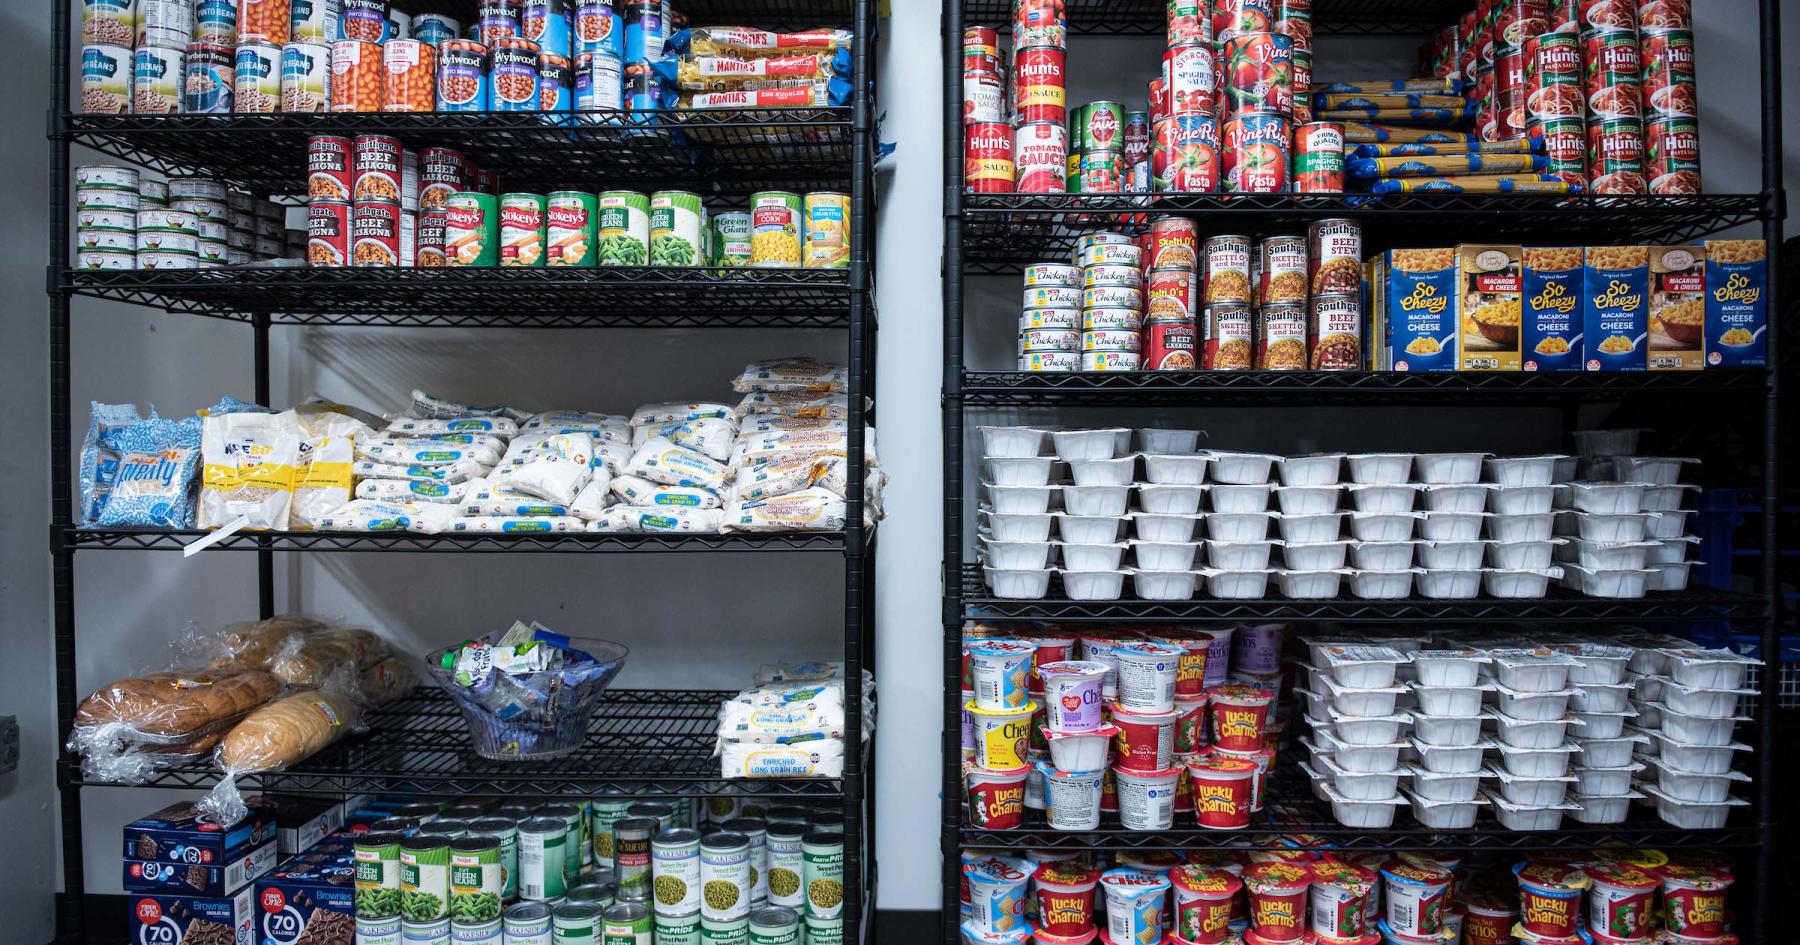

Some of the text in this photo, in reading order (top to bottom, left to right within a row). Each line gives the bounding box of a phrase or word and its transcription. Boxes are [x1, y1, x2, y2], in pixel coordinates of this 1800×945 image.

[210, 53, 230, 62] Beans
[496, 50, 537, 66] Wylwood
[1255, 43, 1289, 64] Vine
[440, 54, 480, 67] Wylwood
[1176, 52, 1195, 69] STAR
[90, 61, 115, 72] BEANS
[1547, 75, 1578, 83] Traditional
[709, 92, 747, 105] MANTIA'S
[1033, 89, 1061, 98] SAUCE
[1087, 120, 1120, 133] SAUCE
[1164, 128, 1200, 148] Vine
[1230, 128, 1264, 150] Vine
[1023, 145, 1063, 153] TOMATO
[1400, 143, 1425, 152] Allegra
[361, 152, 392, 162] BEEF
[1019, 153, 1066, 168] SAUCE
[357, 163, 397, 173] LASAGNA
[427, 164, 457, 174] BEEF
[983, 163, 1011, 172] SAUCE
[1400, 160, 1425, 171] Allegra
[1552, 162, 1583, 170] Traditional
[1609, 162, 1640, 170] Traditional
[422, 174, 461, 184] LASAGNA
[1184, 174, 1210, 188] Pasta
[1248, 174, 1276, 187] Pasta
[1424, 180, 1451, 190] Allegra
[501, 209, 541, 225] Stokely's
[602, 213, 623, 221] GREEN
[722, 218, 748, 227] Green
[761, 214, 781, 223] CORN
[723, 226, 748, 235] Giant
[1319, 224, 1361, 239] Southga
[1158, 236, 1183, 248] Sketti
[1332, 238, 1357, 246] BEEF
[1208, 241, 1250, 256] Southgat
[1268, 241, 1308, 256] Southga
[1331, 246, 1358, 255] STEW
[1107, 249, 1136, 260] Chicken
[1271, 255, 1299, 263] SKETTI
[1215, 260, 1229, 268] and
[1037, 271, 1068, 281] Chicken
[1095, 271, 1125, 280] Chicken
[1727, 273, 1750, 289] So
[1169, 287, 1185, 297] O's
[1412, 281, 1438, 300] So
[1542, 280, 1567, 299] So
[1605, 279, 1631, 296] So
[1094, 292, 1125, 302] Chicken
[1713, 287, 1760, 304] Cheezy
[1317, 299, 1361, 315] Southga
[1400, 295, 1448, 313] Cheezy
[1529, 295, 1577, 313] Cheezy
[1593, 293, 1641, 312] Cheezy
[1094, 313, 1124, 323] Chicken
[1329, 314, 1355, 322] BEEF
[1721, 314, 1754, 322] CHEESE
[1268, 322, 1297, 330] SKETTI
[1328, 322, 1356, 331] STEW
[1407, 323, 1441, 331] CHEESE
[1537, 323, 1570, 331] CHEESE
[1600, 322, 1634, 330] CHEESE
[1225, 328, 1239, 336] and
[1288, 328, 1303, 336] beef
[1032, 334, 1061, 345] Chicken
[1094, 334, 1125, 345] Chicken
[1043, 356, 1073, 367] Chicken
[1226, 711, 1257, 723] Lucky
[1222, 724, 1258, 738] Charms
[763, 758, 796, 766] ENRICHED
[751, 766, 808, 774] LONG GRAIN RICE
[1199, 785, 1233, 798] Lucky
[1198, 799, 1236, 816] Charms
[816, 864, 834, 872] Sweet
[453, 871, 477, 879] GREEN
[453, 877, 477, 886] BEANS
[316, 890, 352, 901] Brownies
[193, 901, 231, 911] Brownies
[1051, 897, 1084, 911] Lucky
[1260, 900, 1293, 914] Lucky
[1531, 896, 1567, 914] Lucky
[273, 915, 296, 931] 70
[1048, 911, 1086, 926] Charms
[1257, 913, 1296, 929] Charms
[1528, 909, 1568, 927] Charms
[149, 926, 173, 941] 70
[669, 924, 694, 935] PRIDE
[773, 933, 795, 944] PRIDE
[813, 937, 831, 945] Sweet
